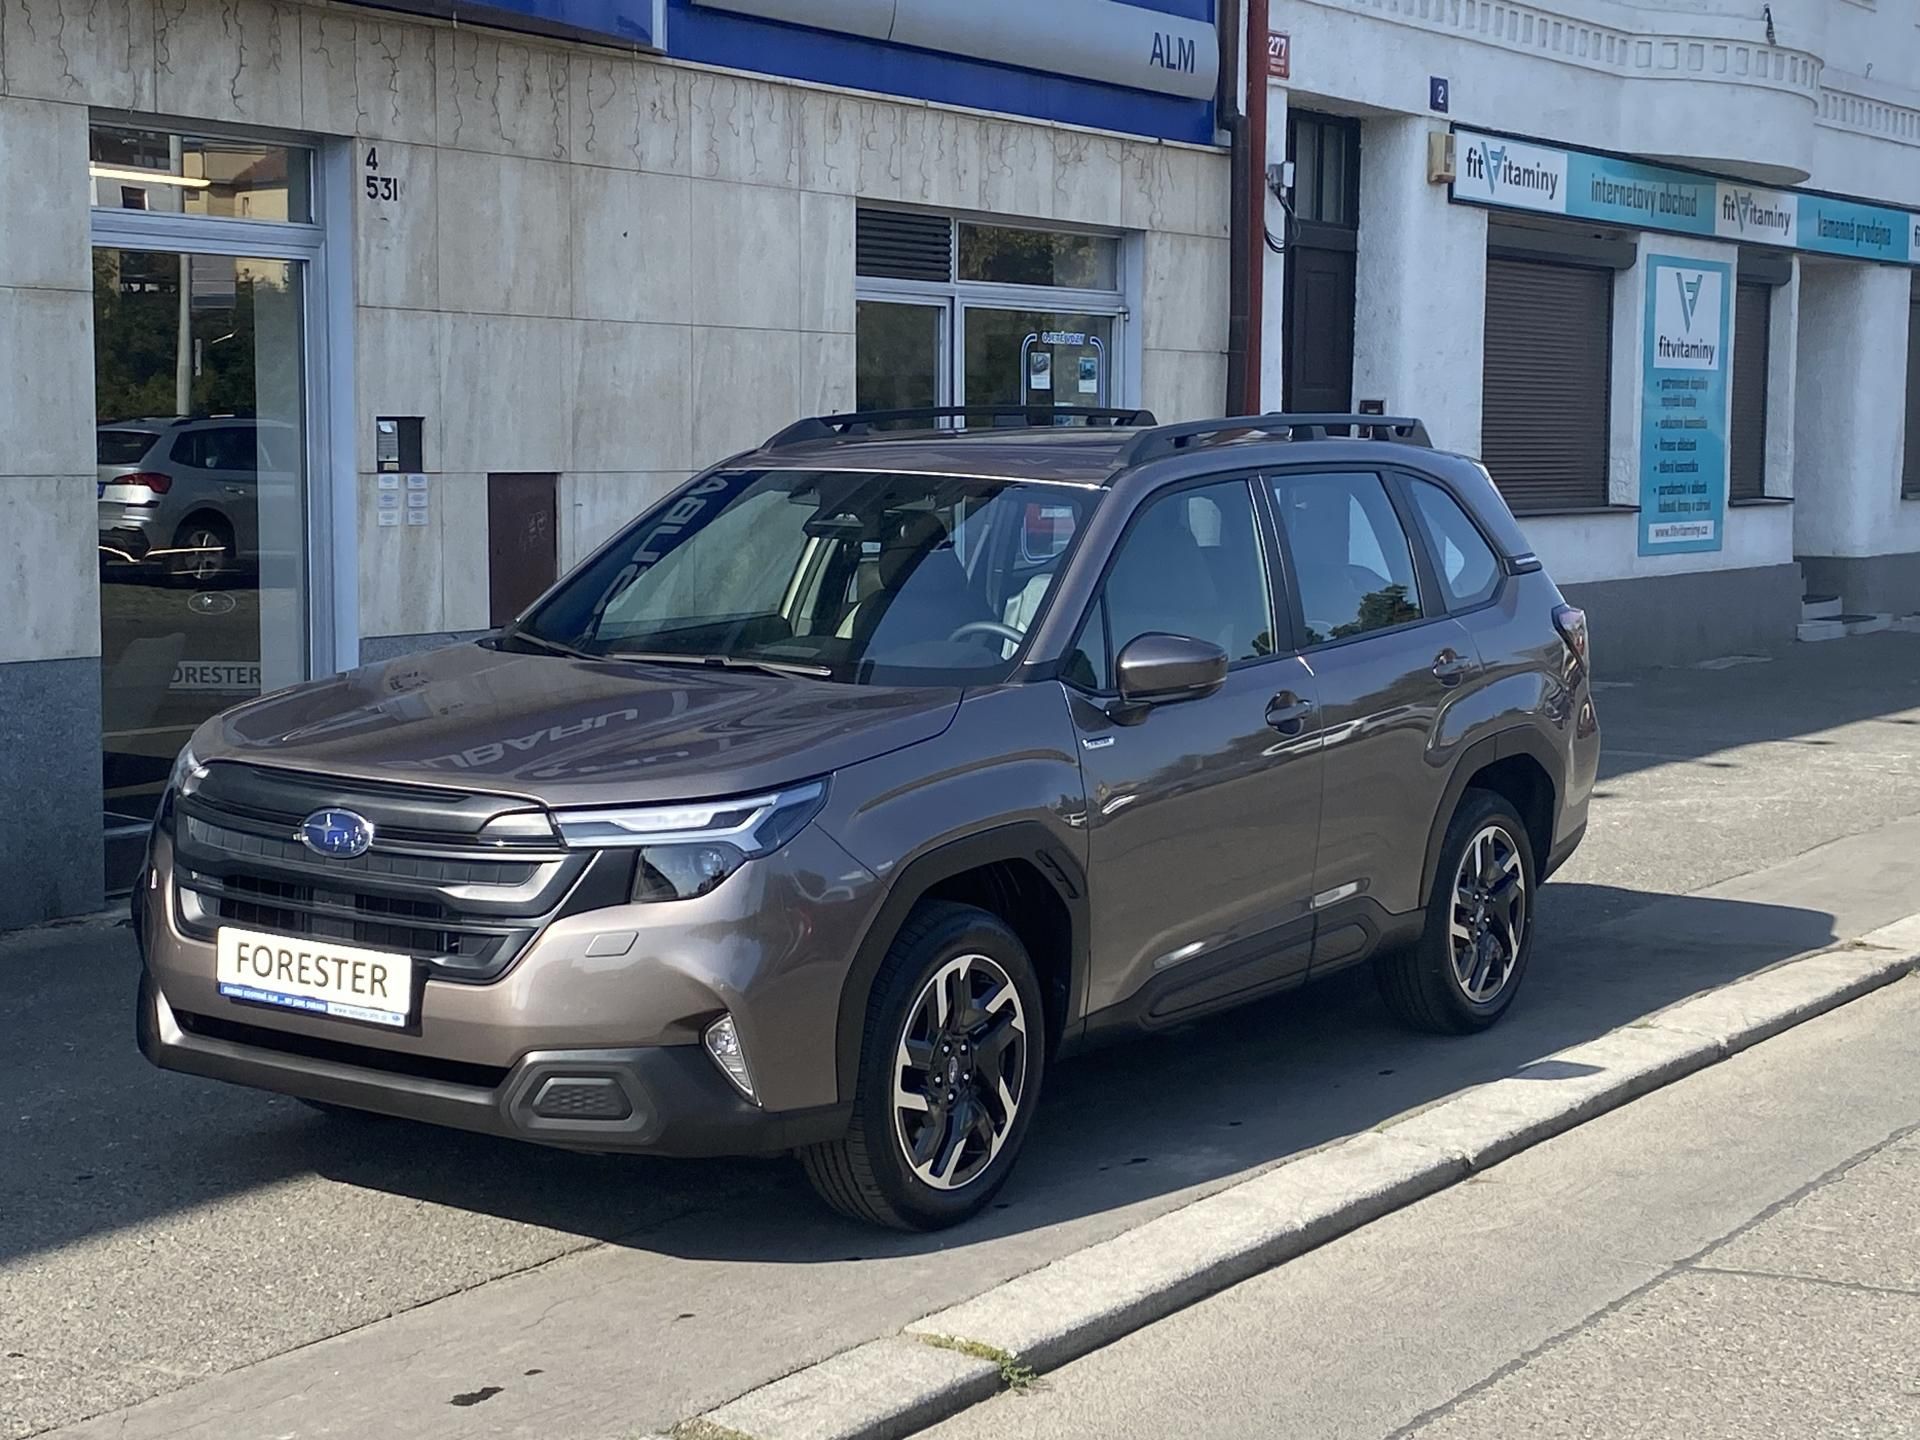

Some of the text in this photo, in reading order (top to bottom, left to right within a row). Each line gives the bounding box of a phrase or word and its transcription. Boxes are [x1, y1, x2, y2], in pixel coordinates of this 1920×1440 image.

[1150, 32, 1195, 74] ALM
[1268, 36, 1286, 56] 277
[1438, 85, 1444, 104] 2
[366, 147, 378, 170] 4
[366, 175, 397, 201] 531
[1591, 173, 1697, 218] internetový obchod
[1659, 335, 1714, 365] fitvitaminy
[237, 942, 388, 998] FORESTER
